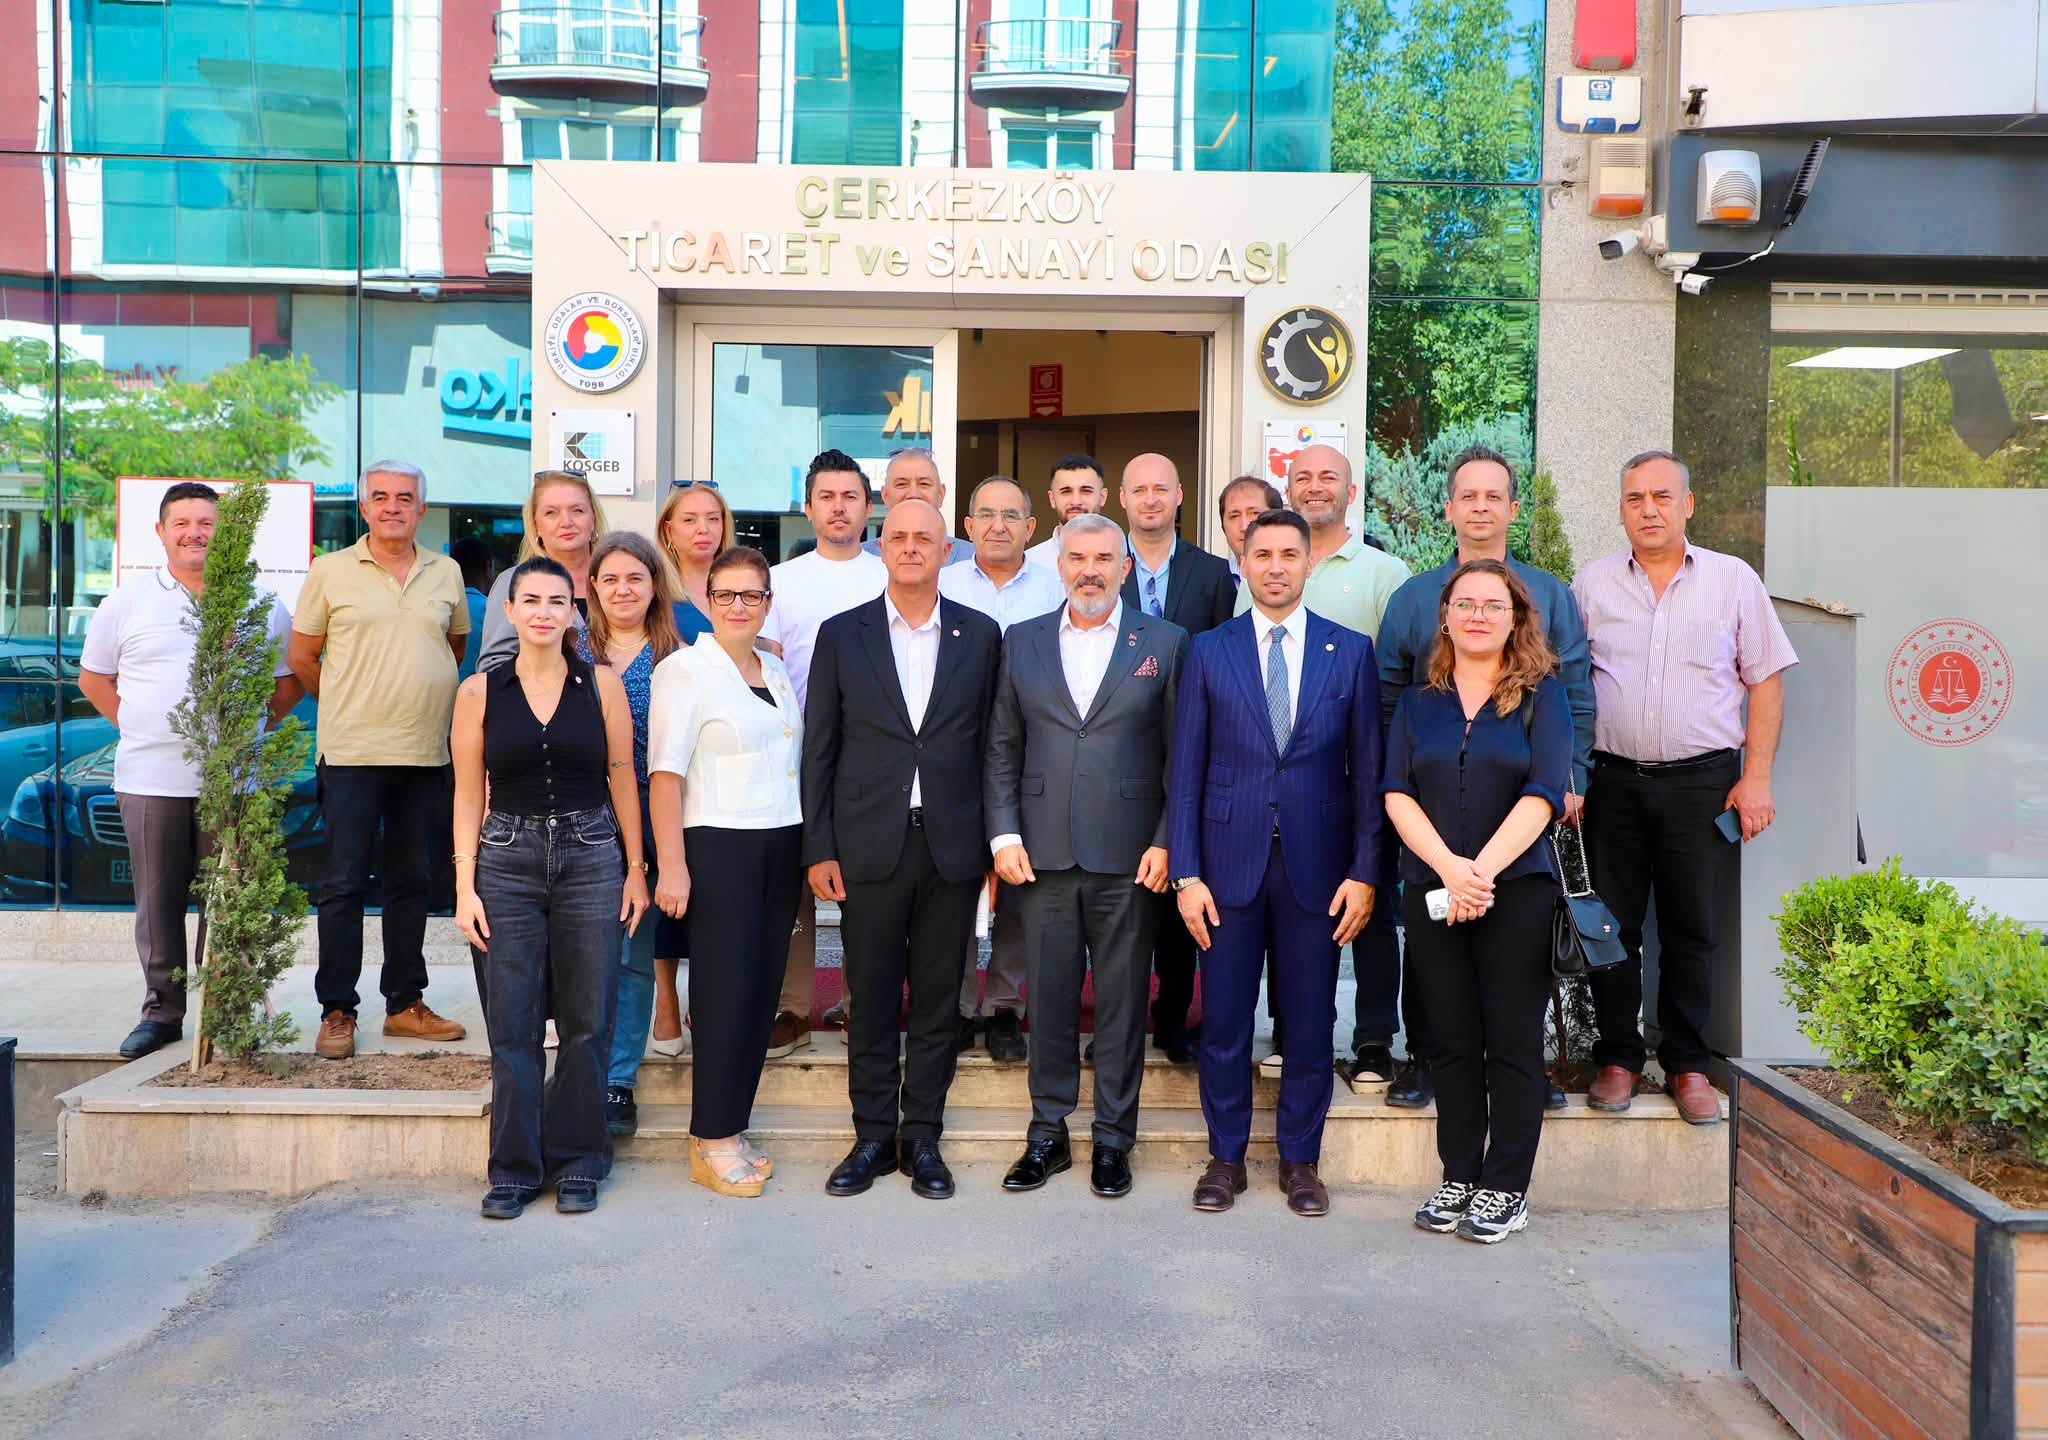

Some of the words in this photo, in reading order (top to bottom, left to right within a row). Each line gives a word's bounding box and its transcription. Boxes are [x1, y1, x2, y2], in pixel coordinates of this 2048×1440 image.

[795, 172, 1114, 227] ÇERKEZKÖY
[619, 220, 841, 275] TİCARET
[855, 242, 911, 277] ve
[925, 228, 1115, 281] SANAYİ
[1131, 239, 1289, 285] ODASI
[587, 296, 600, 305] VE
[563, 460, 620, 473] KOSGEB
